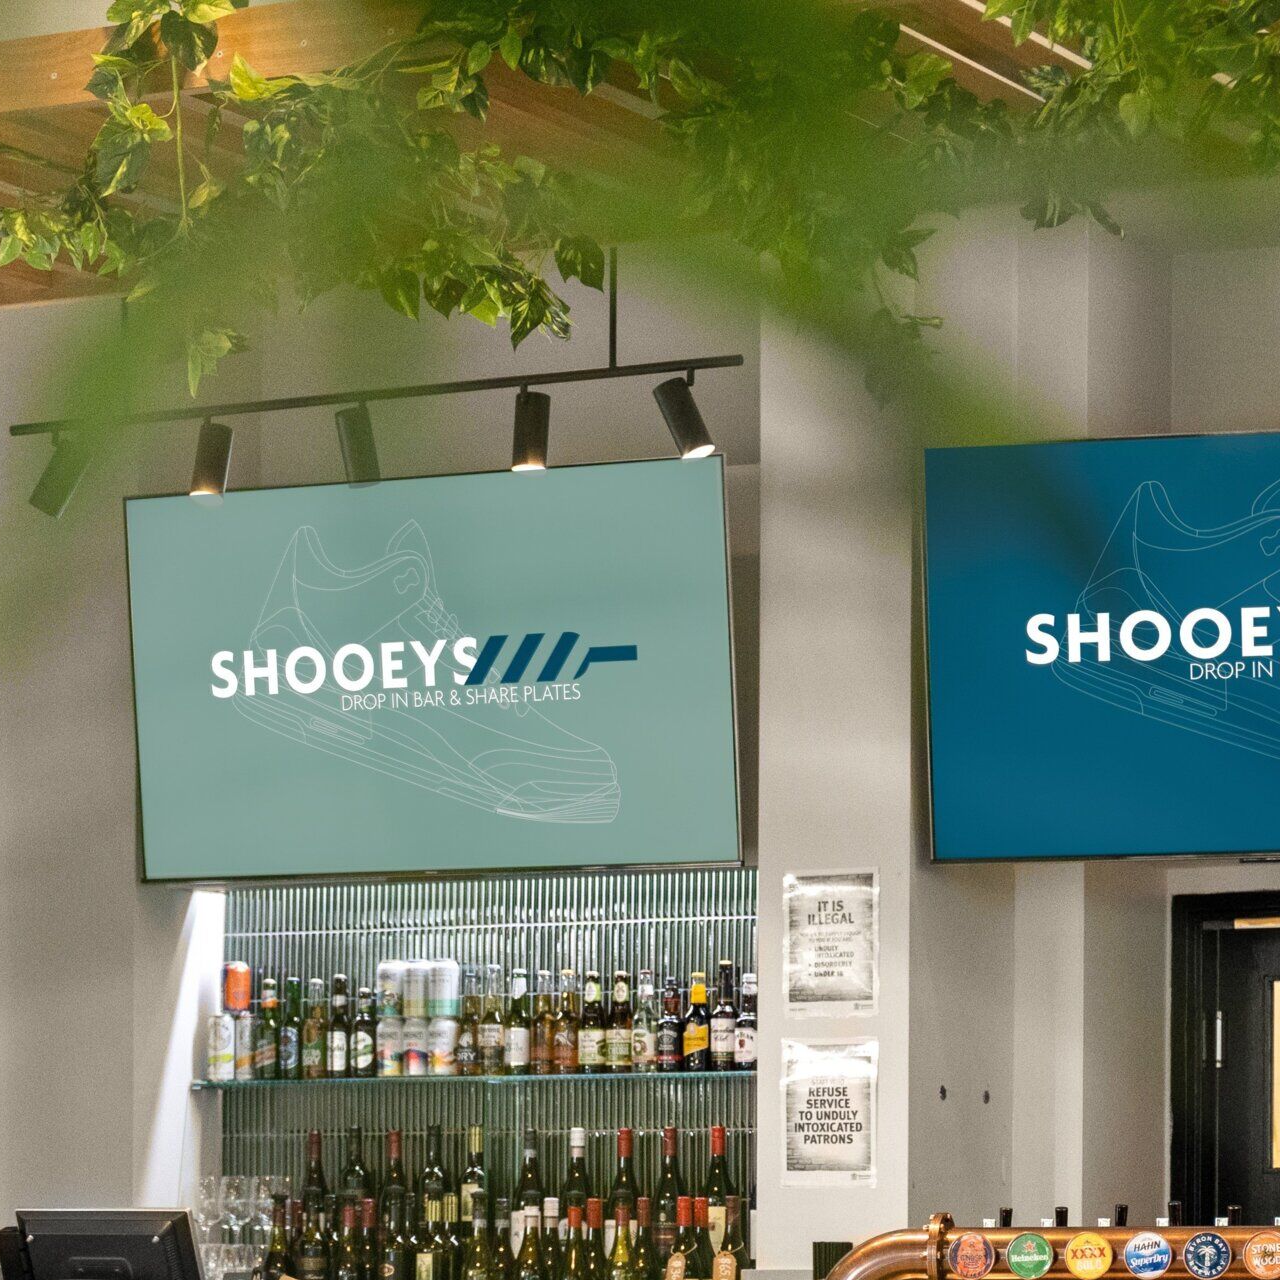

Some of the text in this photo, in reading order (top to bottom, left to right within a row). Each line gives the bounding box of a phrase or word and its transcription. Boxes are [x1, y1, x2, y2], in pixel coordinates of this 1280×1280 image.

[210, 636, 477, 698] SHOOEYS
[1189, 659, 1247, 680] DROP
[1252, 658, 1274, 678] IN
[341, 683, 582, 711] DROP IN BAR & SHARE PLATES
[818, 900, 844, 912] IT IS
[807, 912, 855, 925] ILLEGAL
[808, 1086, 848, 1097] REFUSE
[806, 1098, 851, 1109] SERVICE
[799, 1110, 858, 1121] TO UNDULY
[794, 1122, 863, 1133] INTOXICATED
[803, 1134, 854, 1145] PATRONS
[1133, 1241, 1161, 1251] HAHN
[1188, 1234, 1227, 1252] BYRON BAY
[1011, 1254, 1049, 1263] Heineken
[1071, 1247, 1106, 1260] XXXX
[1129, 1253, 1169, 1268] SuperDry
[1187, 1259, 1227, 1277] BREWERY
